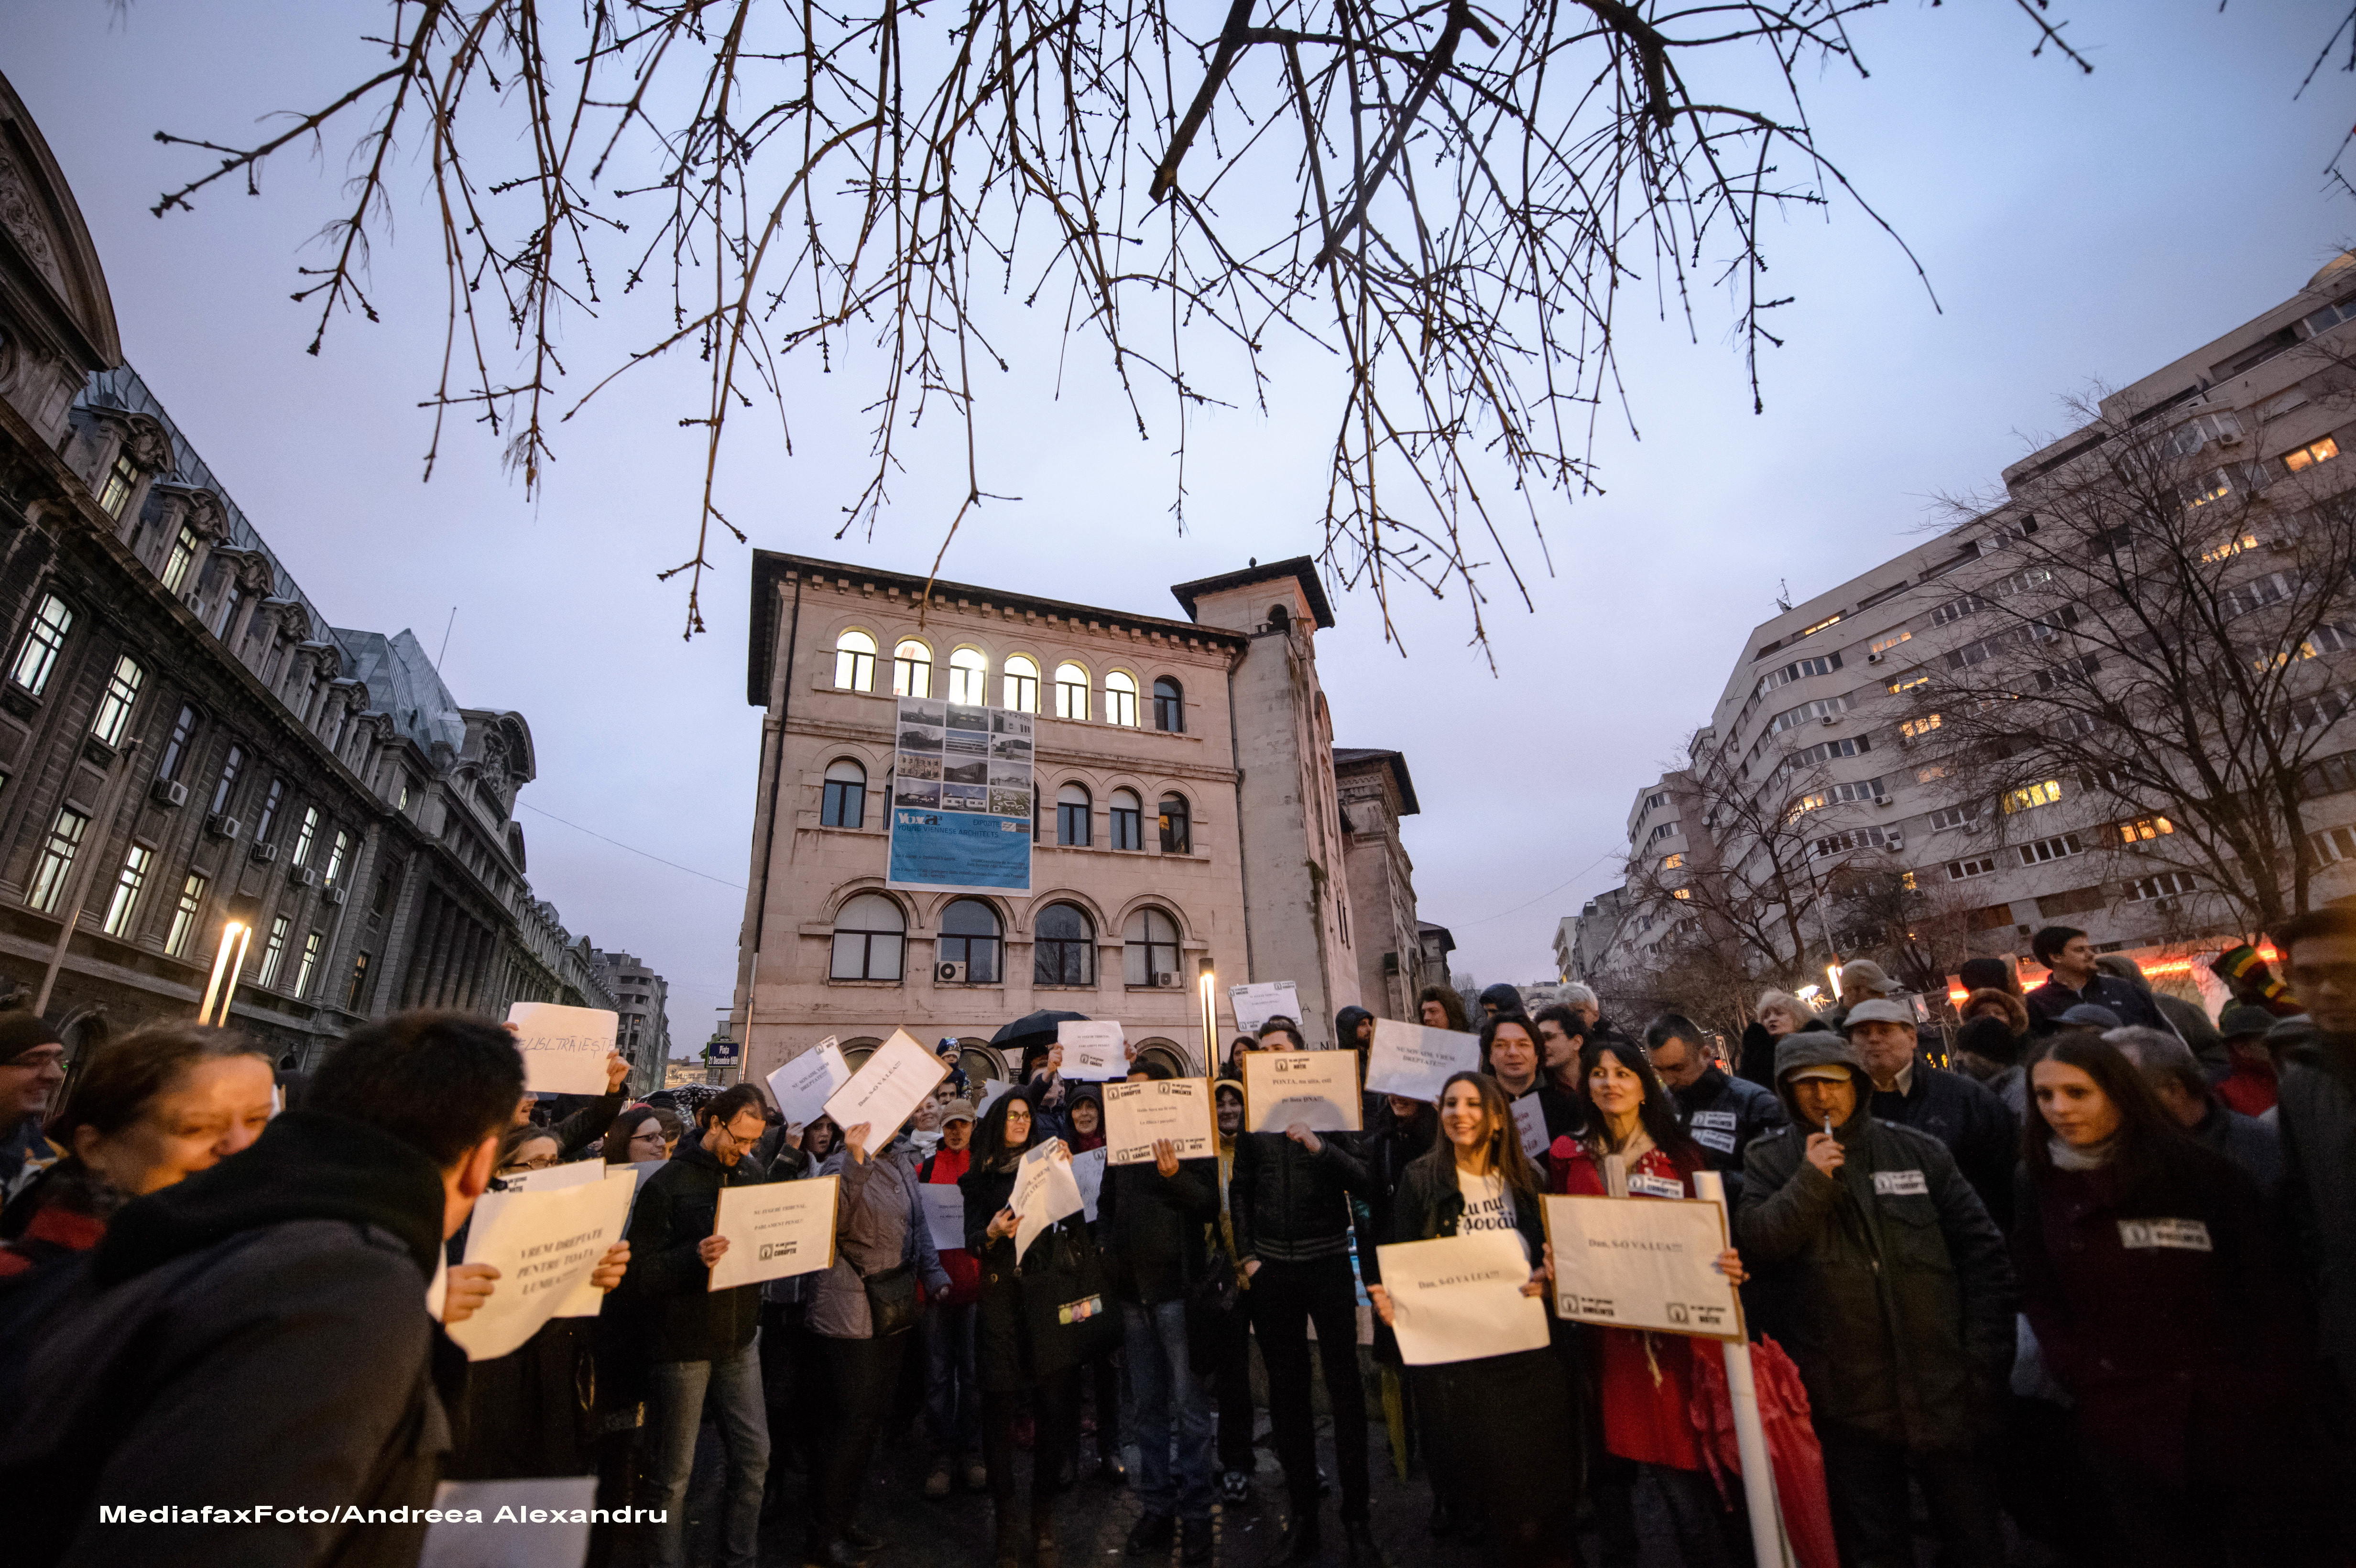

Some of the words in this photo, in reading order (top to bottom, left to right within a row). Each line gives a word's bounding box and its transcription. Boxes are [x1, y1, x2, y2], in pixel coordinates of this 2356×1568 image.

[923, 827, 957, 835] VIENNESE
[959, 829, 999, 838] ARCHITECTS
[720, 1045, 730, 1056] Piața
[709, 1056, 713, 1065] 21
[713, 1056, 730, 1065] Decembrie
[1436, 1053, 1455, 1061] VREM
[817, 1062, 829, 1075] VREM
[1482, 1196, 1505, 1212] nu
[521, 1242, 554, 1259] VREM
[555, 1227, 603, 1252] DREPTATE
[1588, 1239, 1610, 1248] Dan,
[1611, 1240, 1629, 1249] S-O
[517, 1258, 560, 1279] PENTRU
[1418, 1281, 1437, 1289] Dan,
